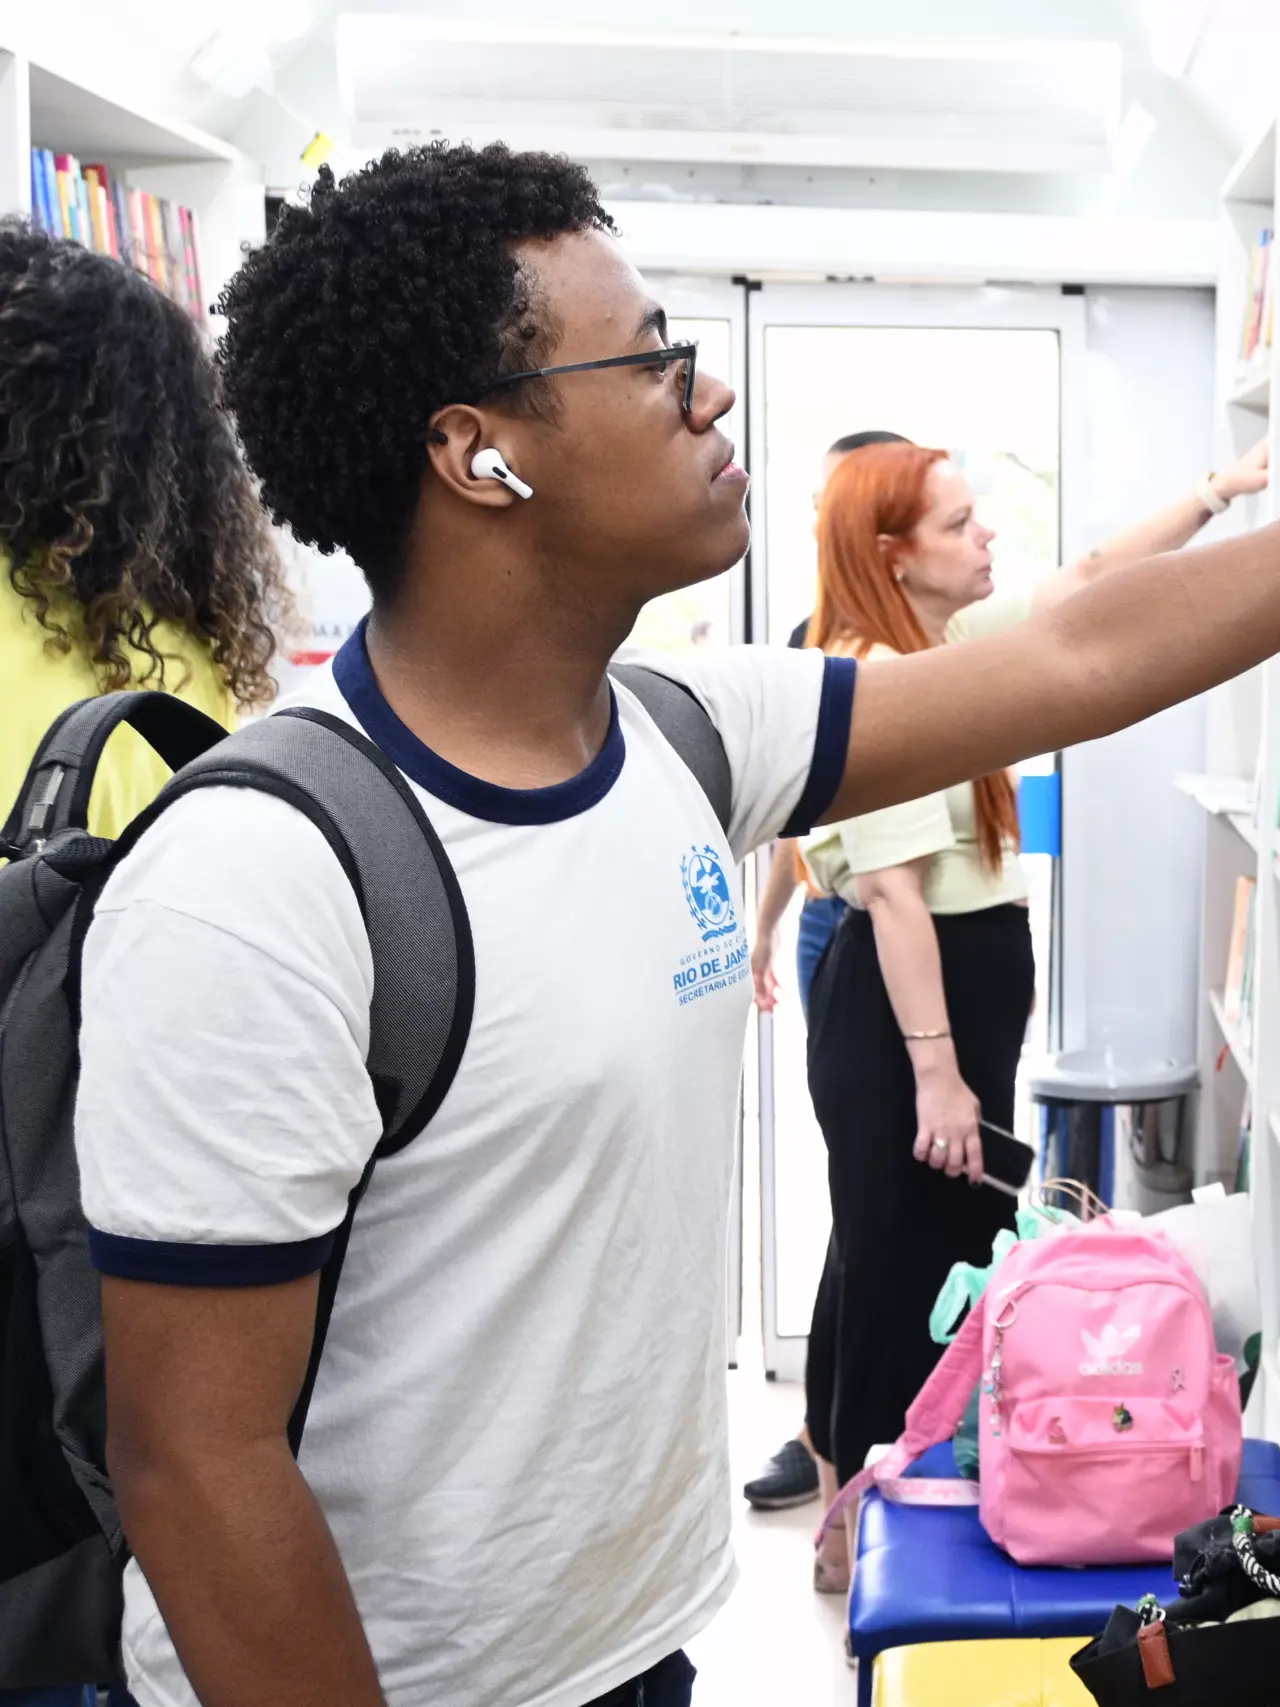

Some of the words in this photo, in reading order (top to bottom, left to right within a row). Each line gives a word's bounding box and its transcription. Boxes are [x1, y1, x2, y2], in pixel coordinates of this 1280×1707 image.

[680, 944, 720, 966] GOVERNO
[672, 967, 698, 990] RIO
[700, 957, 721, 978] DE
[679, 979, 727, 1006] SECRETARIA
[728, 975, 737, 985] DE
[1079, 1360, 1144, 1375] adidas
